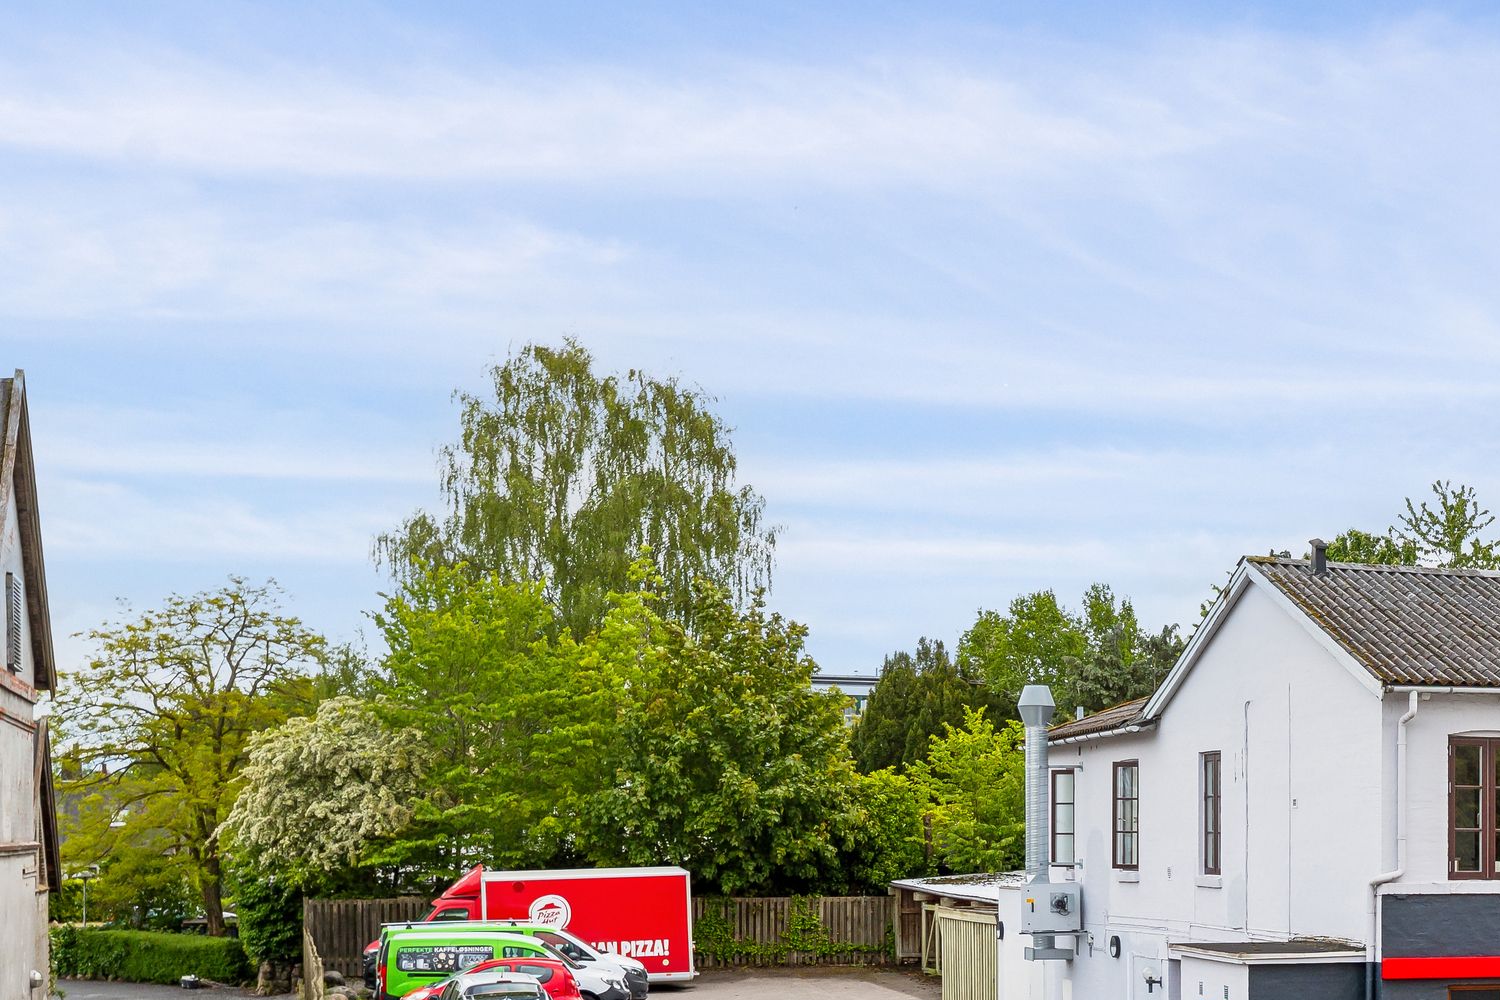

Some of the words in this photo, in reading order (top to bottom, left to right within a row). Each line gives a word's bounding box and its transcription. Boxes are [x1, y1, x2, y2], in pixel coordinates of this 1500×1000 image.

[537, 910, 561, 920] Pizza
[541, 917, 558, 925] Hut
[591, 941, 618, 956] AN
[621, 939, 670, 957] PIZZA!
